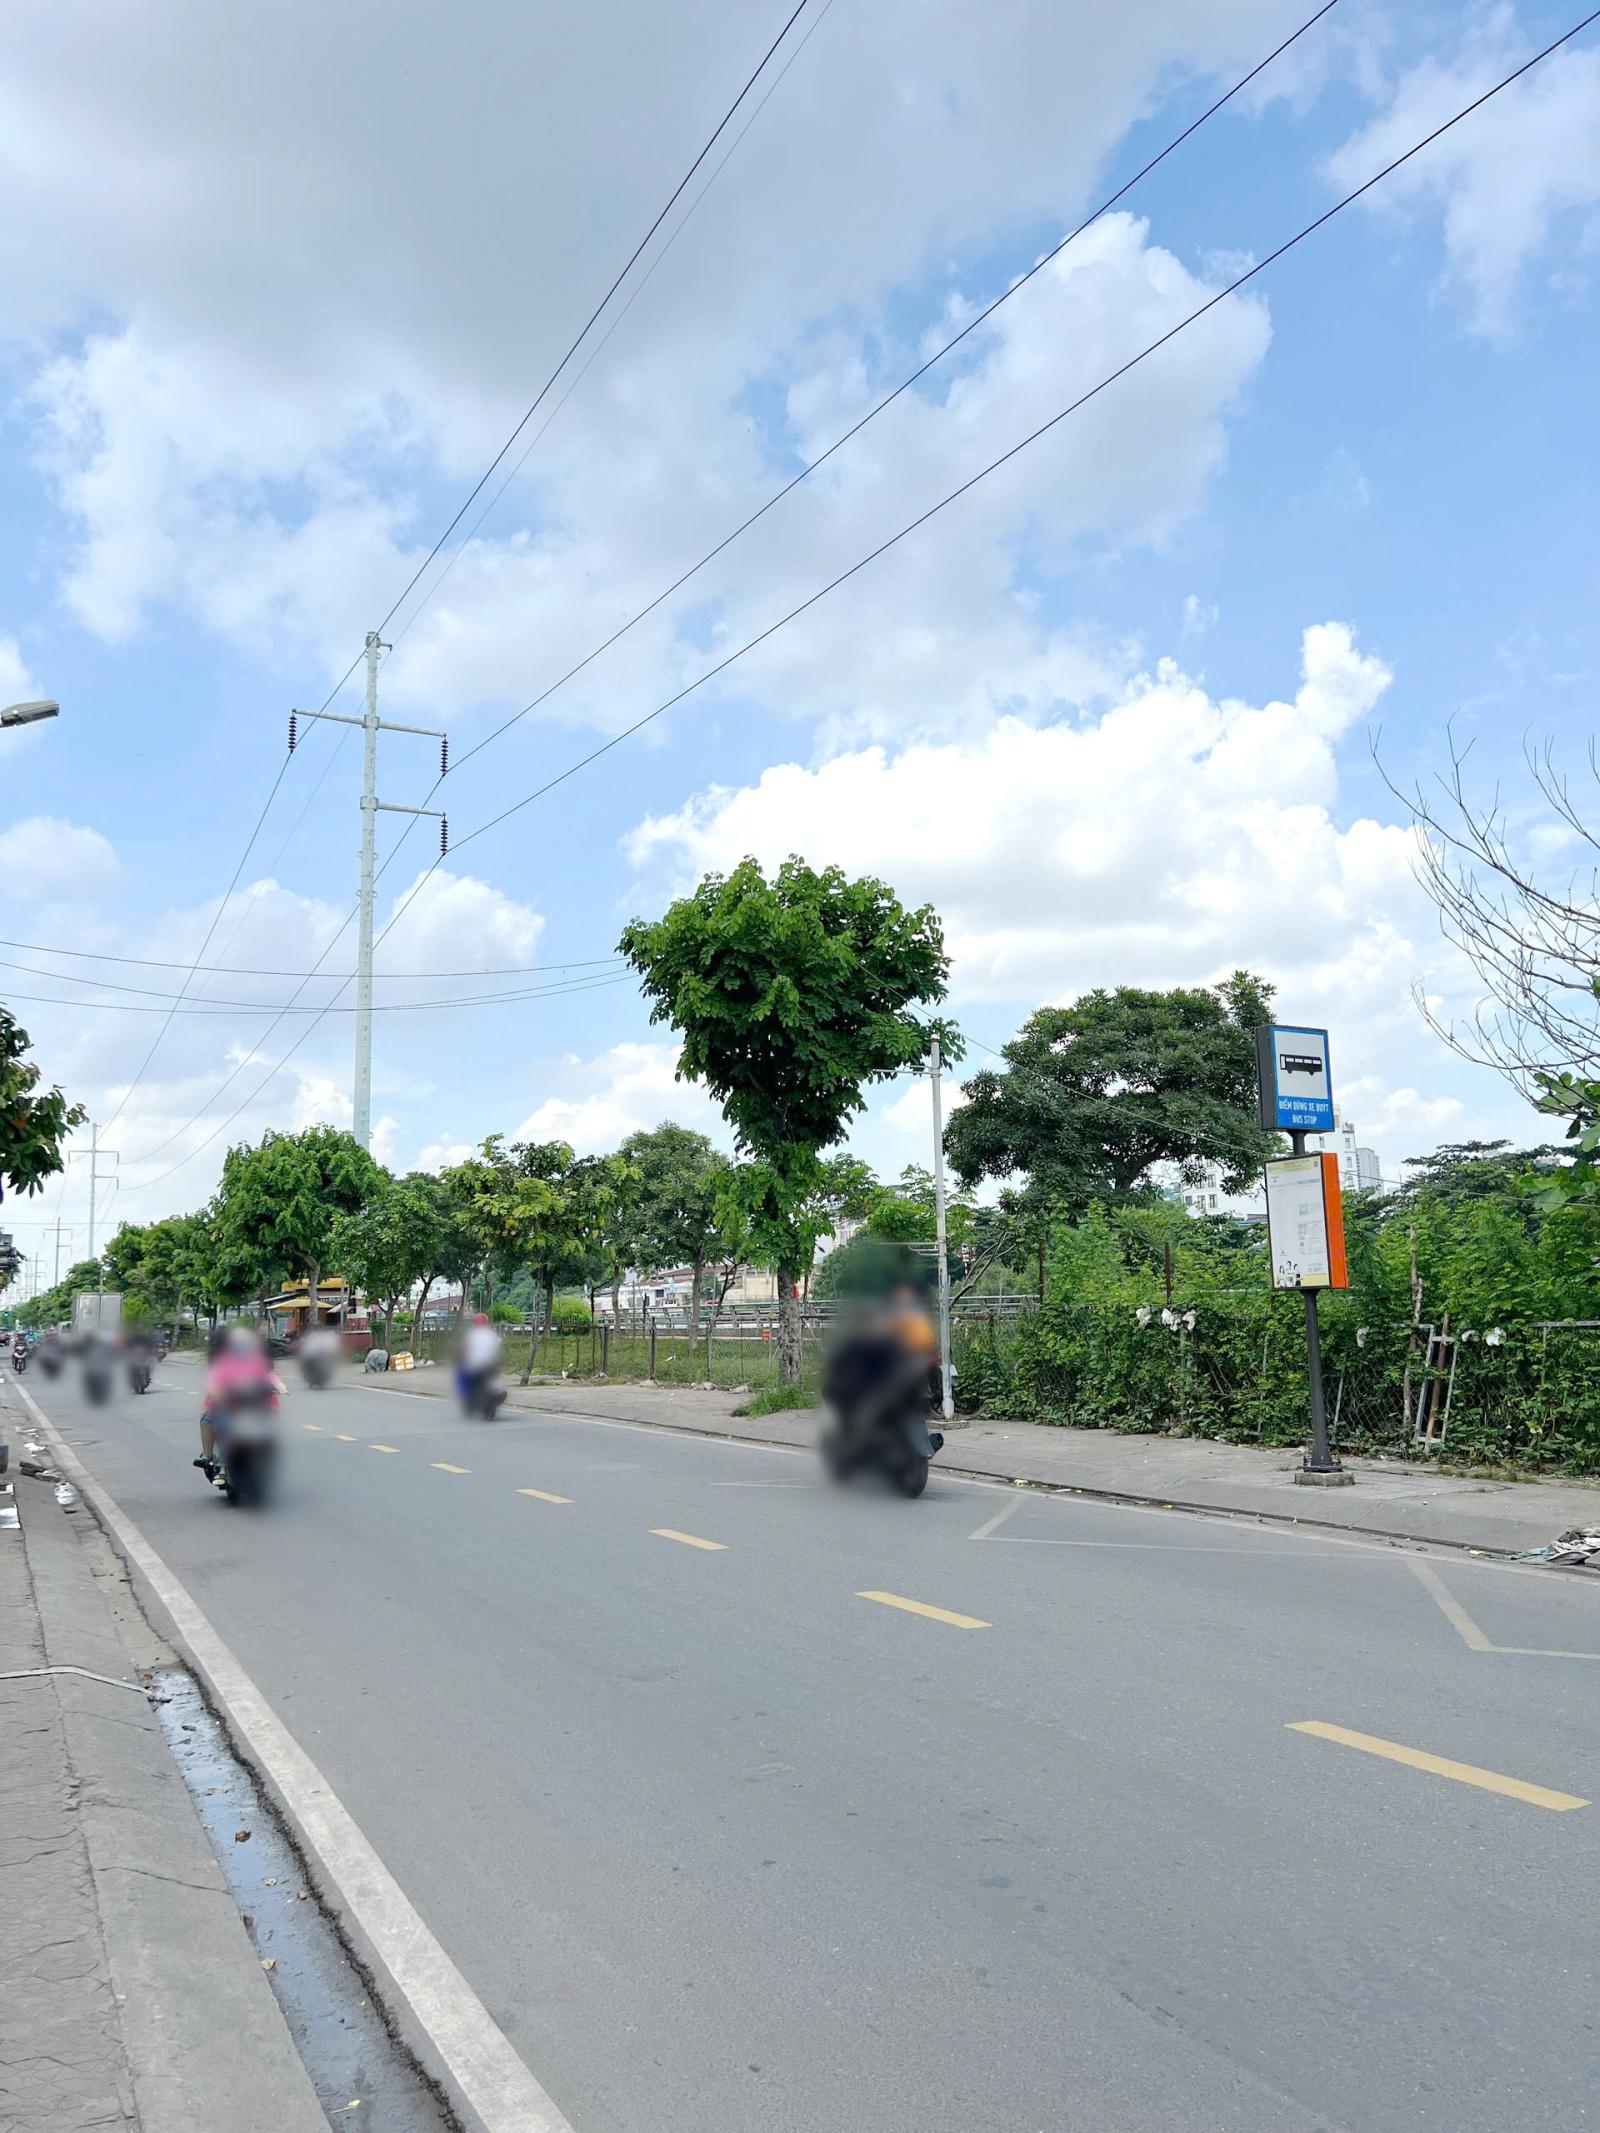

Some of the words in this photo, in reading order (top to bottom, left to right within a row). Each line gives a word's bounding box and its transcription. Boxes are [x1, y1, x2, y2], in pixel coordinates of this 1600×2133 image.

[1308, 1102, 1315, 1112] XE
[1292, 1114, 1303, 1124] BUS
[1304, 1115, 1318, 1125] STOP
